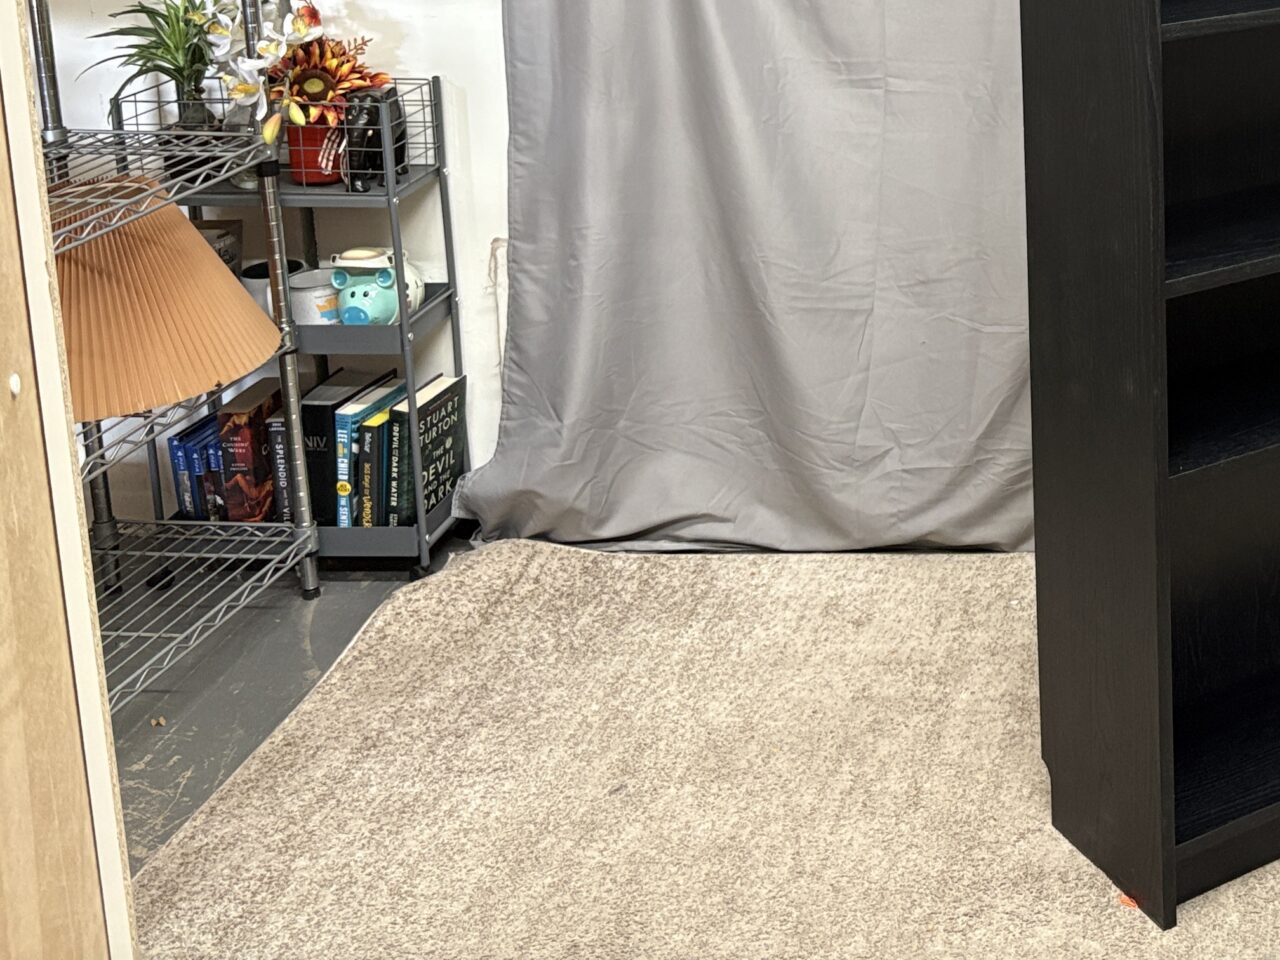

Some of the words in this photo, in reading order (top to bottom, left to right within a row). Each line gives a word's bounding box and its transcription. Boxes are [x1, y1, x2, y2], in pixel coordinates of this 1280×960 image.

[419, 396, 458, 433] STUART
[338, 430, 348, 442] LEE
[419, 411, 458, 448] TURTON
[304, 436, 326, 448] NIV
[432, 445, 444, 460] THE
[338, 458, 349, 480] CHILD
[422, 450, 456, 486] DEVIL
[275, 444, 288, 488] SPLENDID
[283, 508, 291, 523] VIL
[340, 506, 348, 528] SENTI
